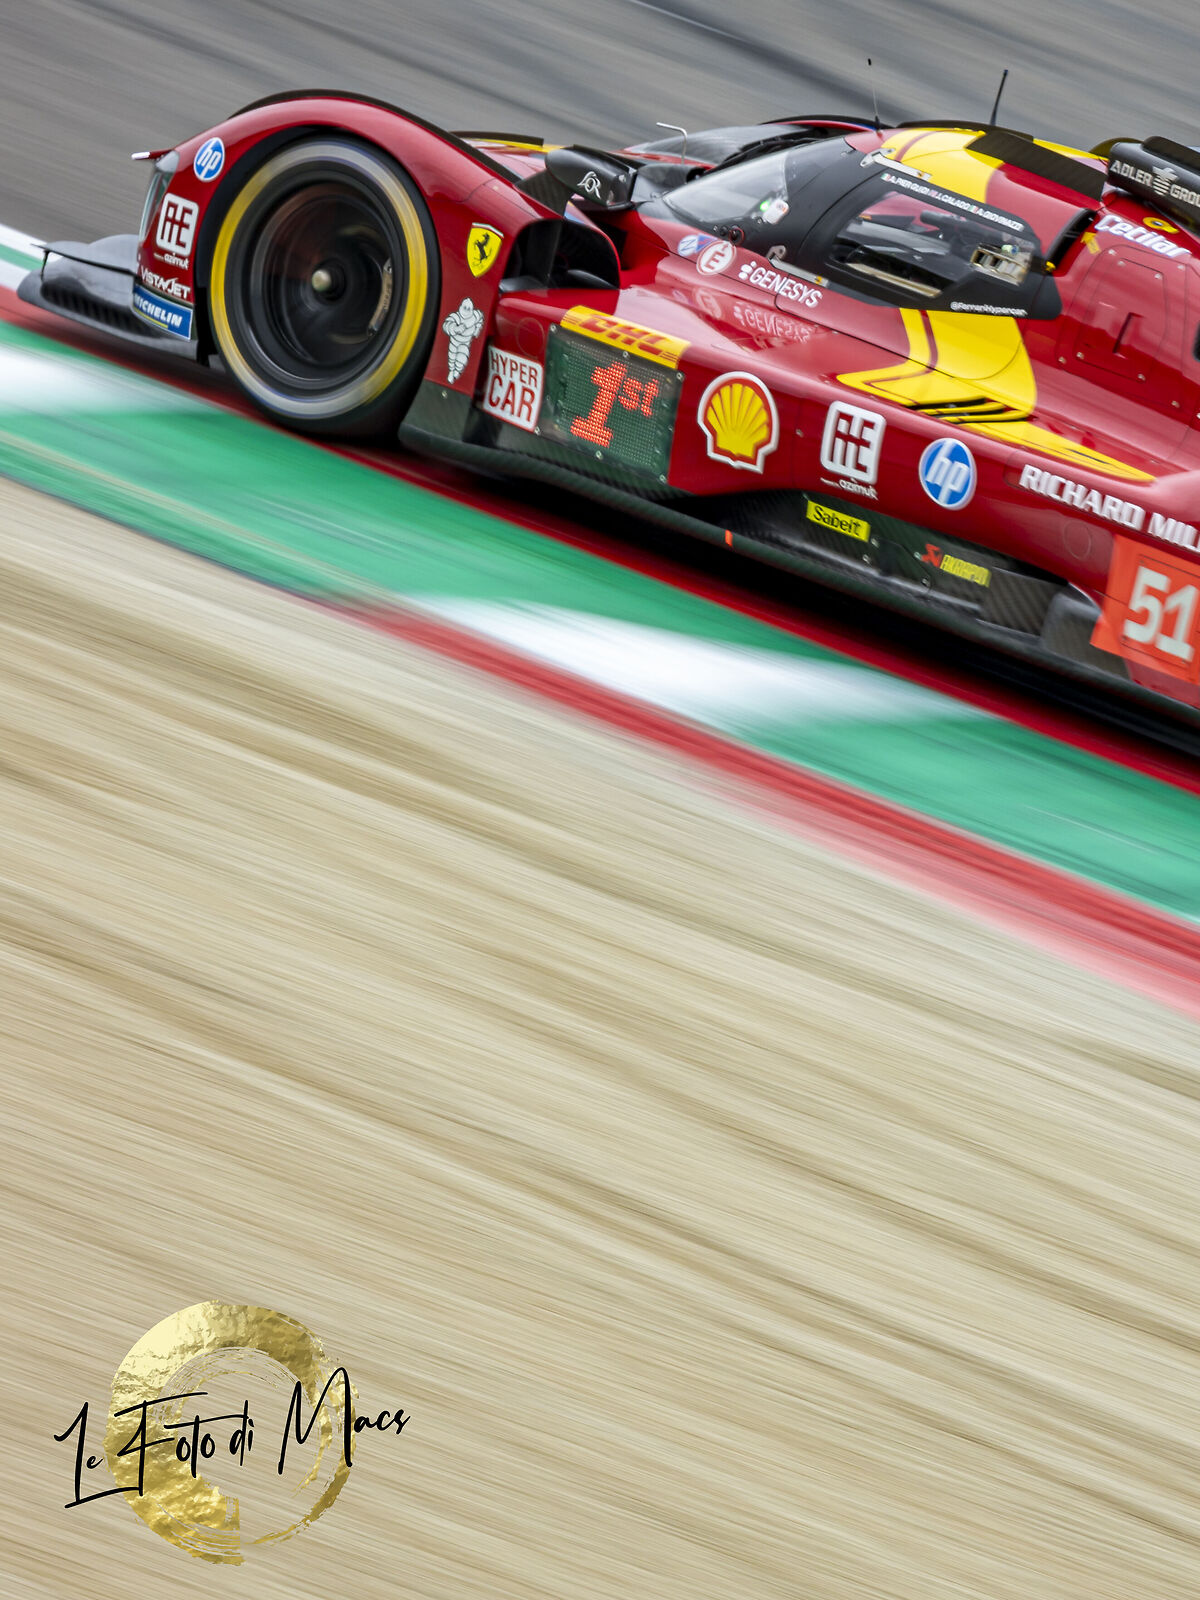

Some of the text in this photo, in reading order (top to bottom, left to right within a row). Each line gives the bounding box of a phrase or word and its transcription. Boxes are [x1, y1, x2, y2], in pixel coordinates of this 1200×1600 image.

[196, 138, 222, 179] hp
[1109, 160, 1153, 188] ADLER
[141, 264, 191, 299] VISTAJET
[163, 252, 190, 271] azimut
[749, 266, 823, 308] GENESYS
[578, 313, 672, 356] DHL
[491, 350, 539, 388] HYPER
[488, 372, 536, 423] CAR
[570, 361, 660, 448] 1st
[838, 478, 879, 501] azimut
[925, 440, 971, 504] hp
[1018, 464, 1147, 532] RICHARD
[813, 505, 861, 536] Sabelt
[1122, 565, 1200, 662] 51
